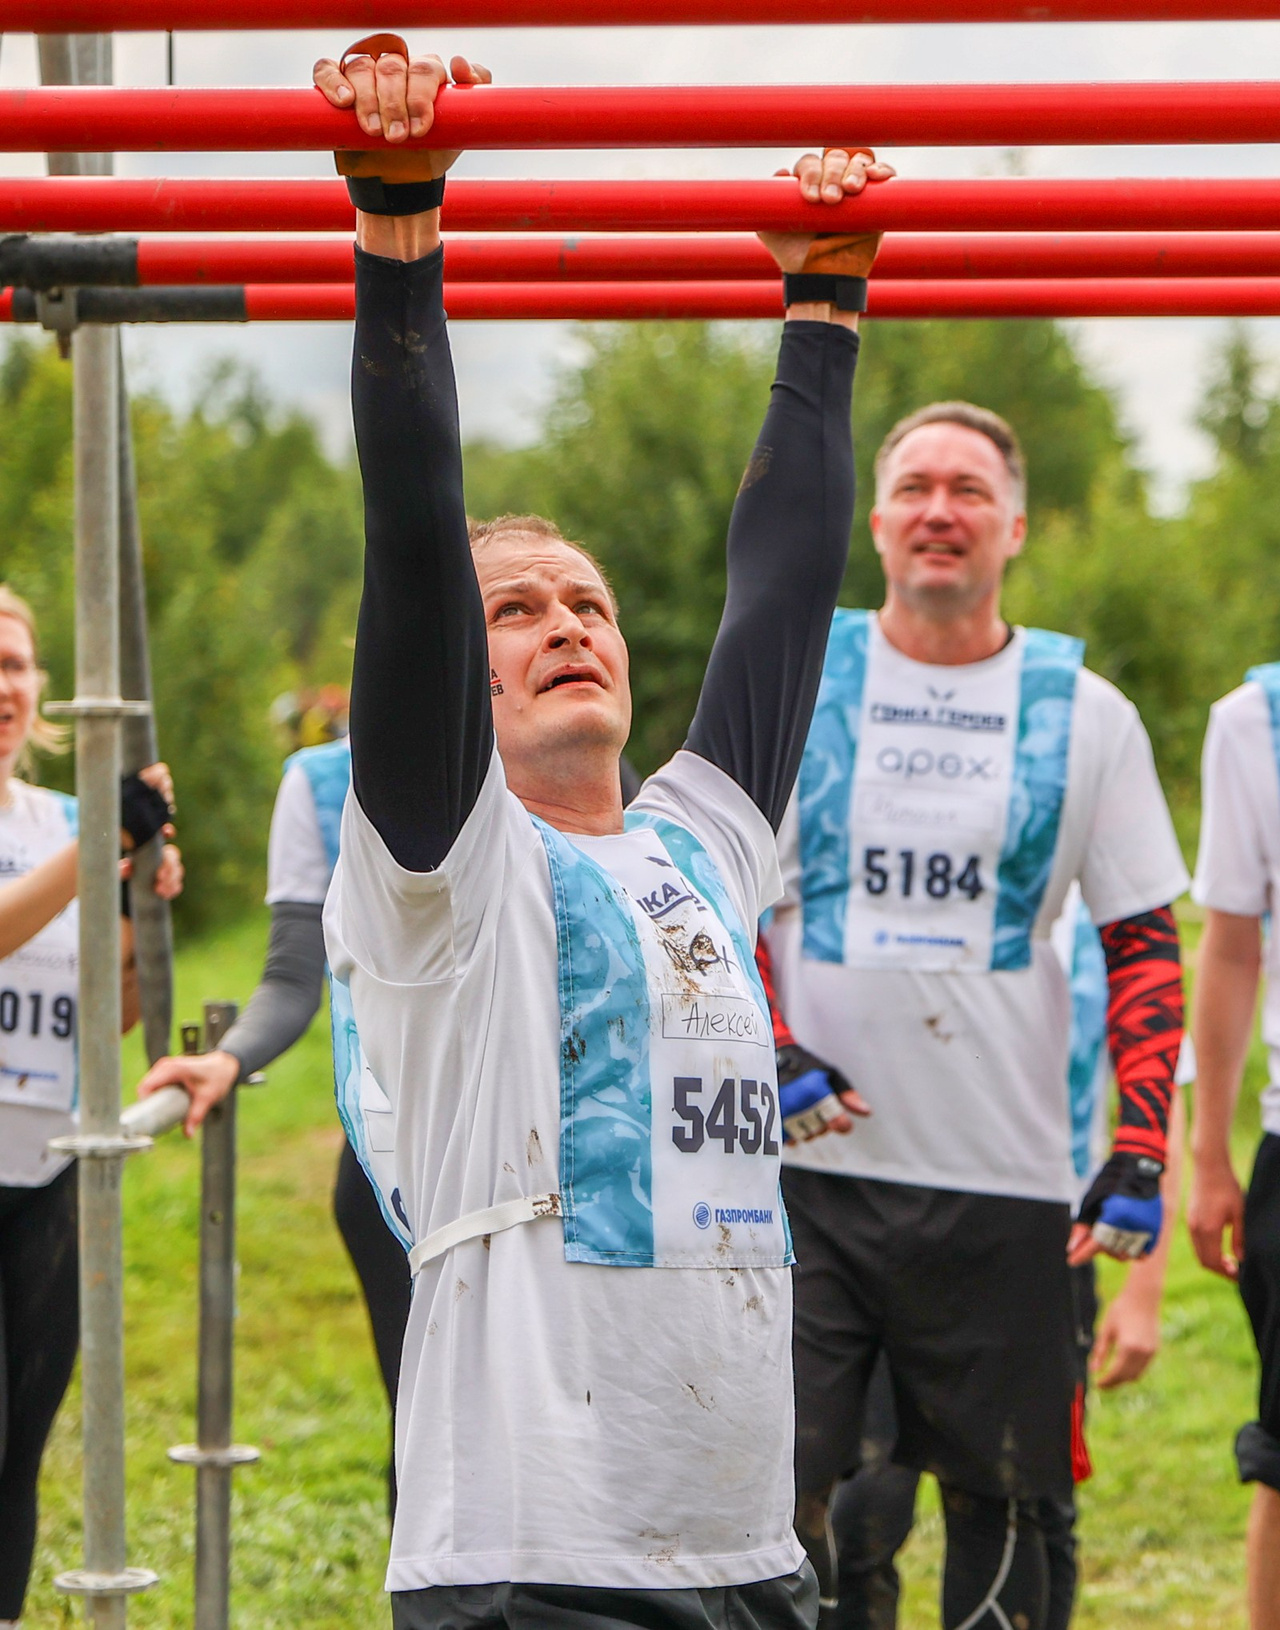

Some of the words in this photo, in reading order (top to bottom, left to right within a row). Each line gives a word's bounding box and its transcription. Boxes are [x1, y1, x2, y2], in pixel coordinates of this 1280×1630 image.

[864, 847, 984, 901] 5184
[672, 1077, 779, 1156] 5452
[714, 1208, 774, 1225] ГАЗПРОМБАНК
